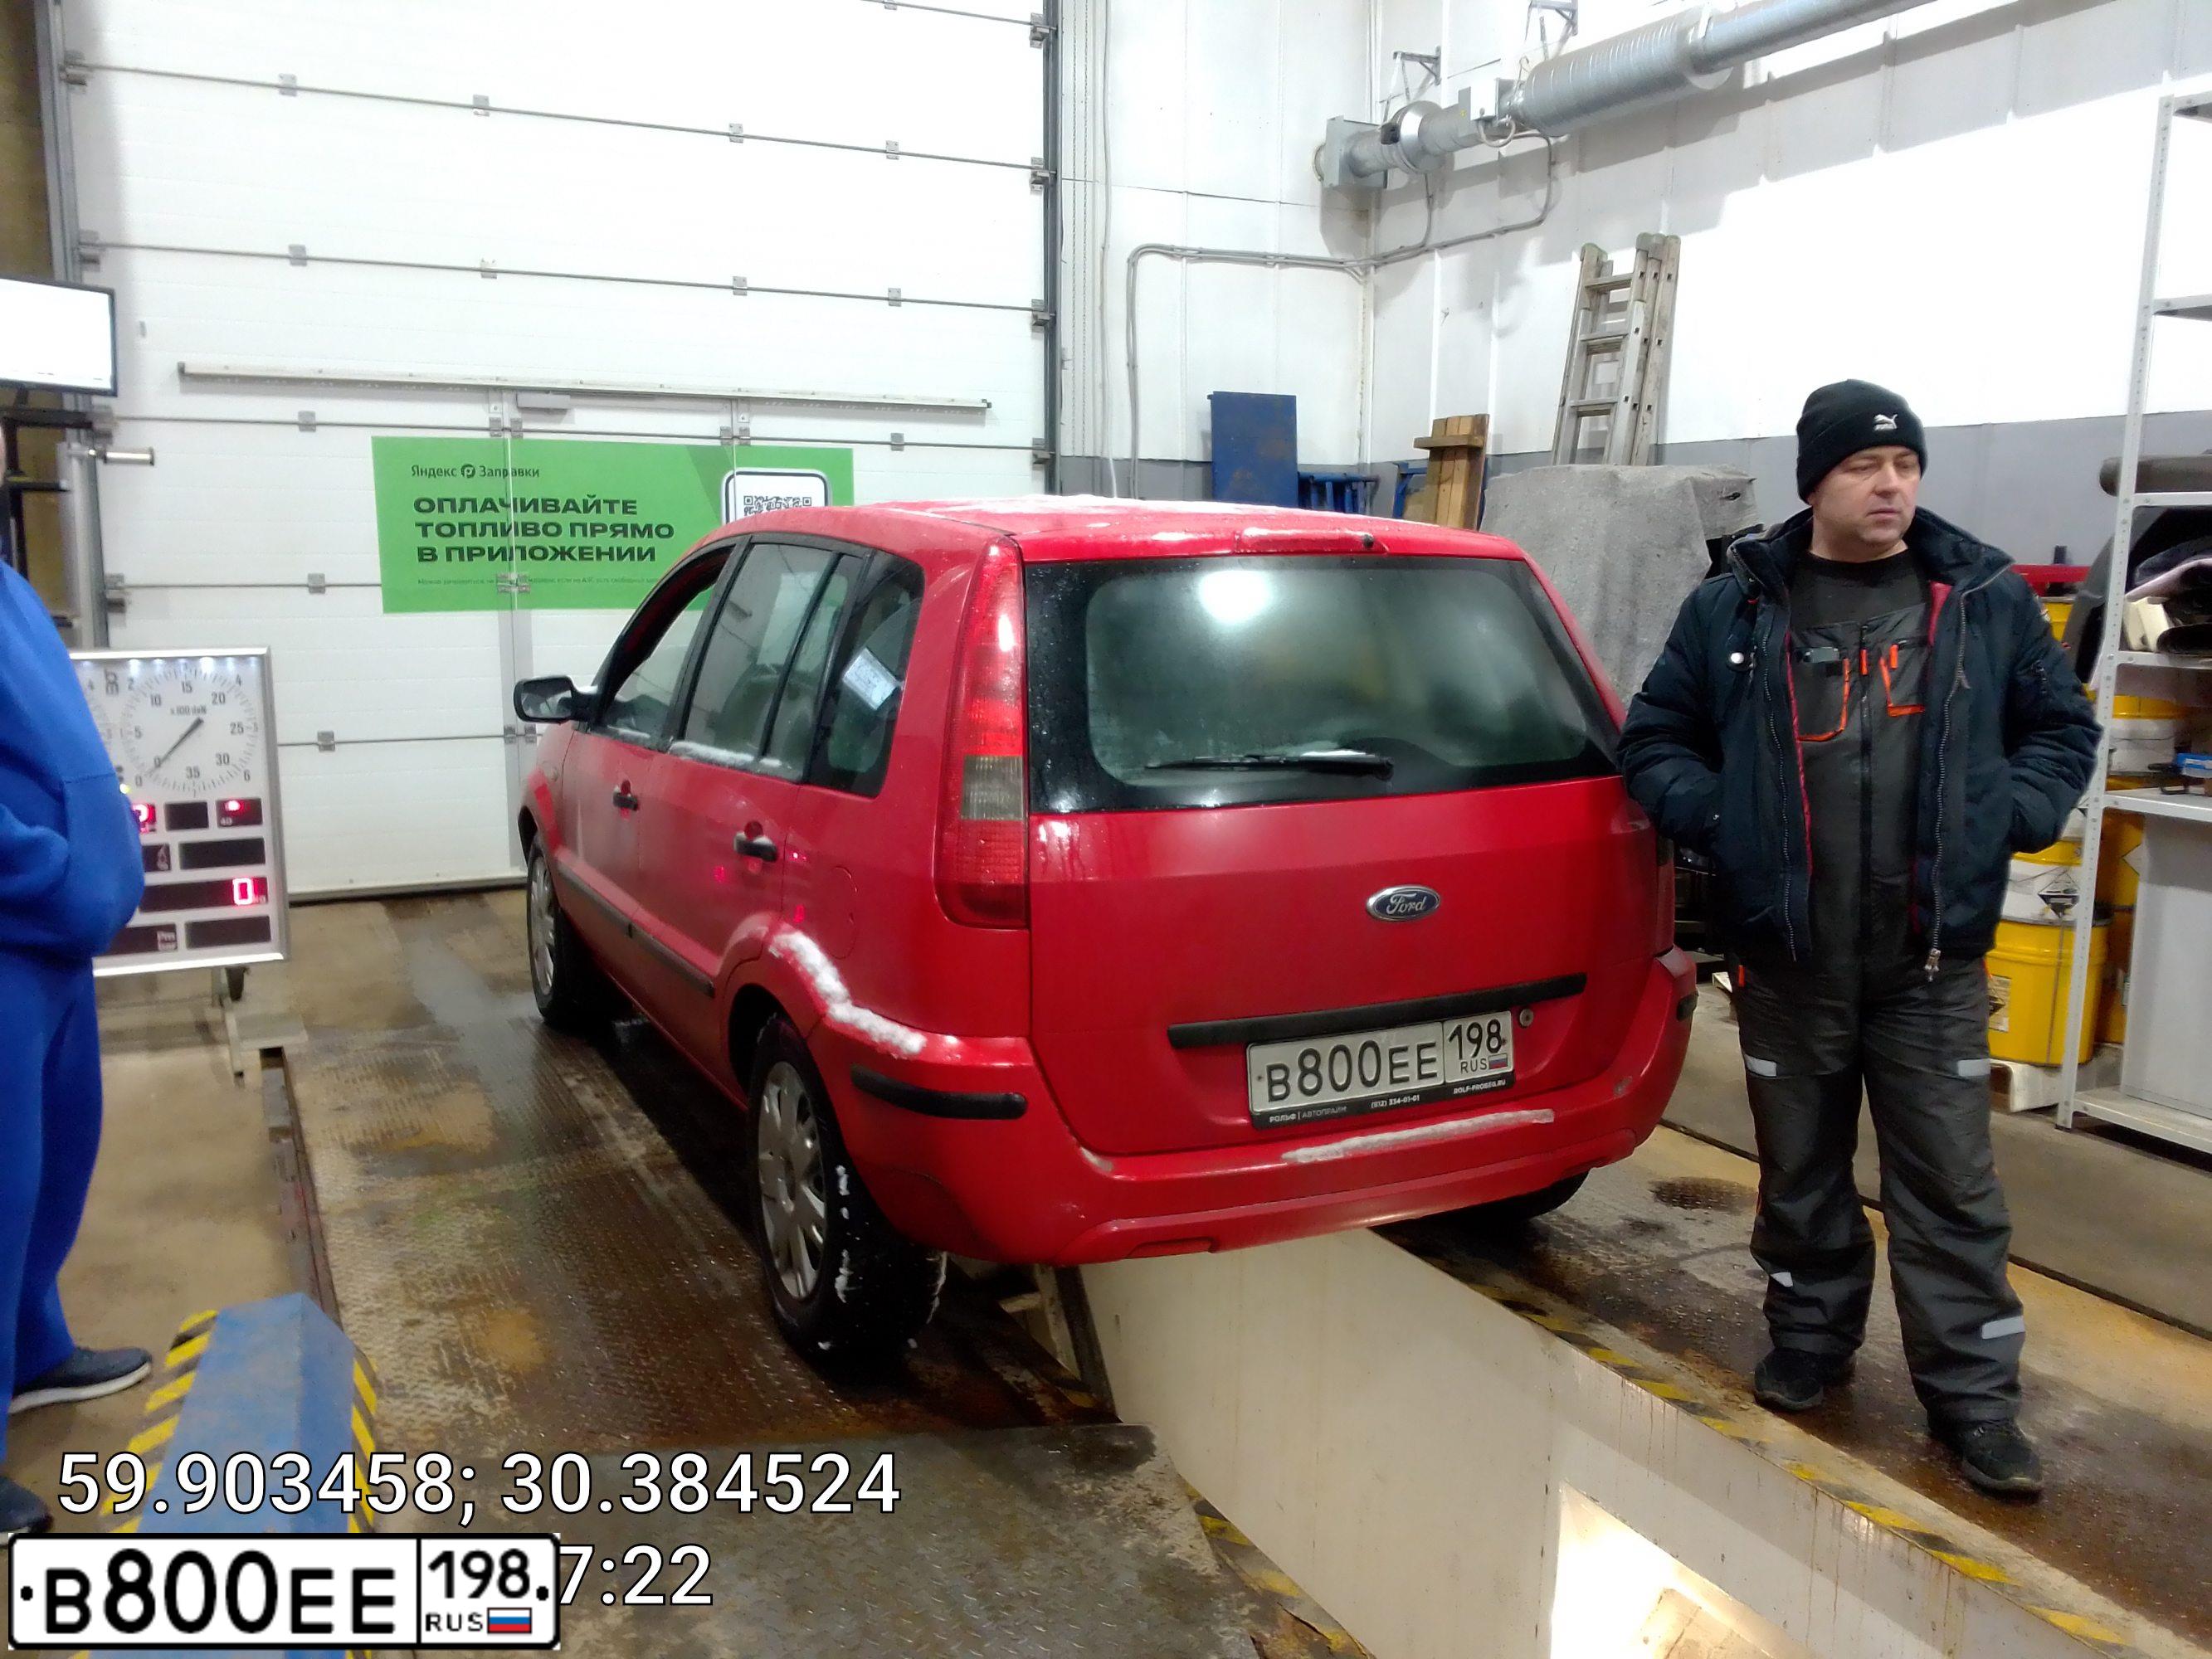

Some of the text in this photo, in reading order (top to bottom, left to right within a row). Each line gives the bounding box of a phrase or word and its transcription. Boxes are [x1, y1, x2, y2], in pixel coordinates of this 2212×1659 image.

[411, 464, 540, 479] Яндекс Заправки
[413, 494, 638, 515] ОПЛАЧИВАЙТЕ
[415, 521, 675, 540] ТОПЛИВО ПРЯМО
[417, 544, 656, 563] В ПРИЛОЖЕНИИ
[181, 680, 193, 694] 15
[149, 693, 162, 708] 10
[211, 691, 226, 705] 20
[134, 725, 143, 739] 5
[230, 721, 244, 735] 25
[215, 752, 230, 766] 30
[185, 765, 200, 779] 35
[232, 877, 256, 906] 0
[1386, 892, 1428, 916] Ford
[1448, 1018, 1503, 1061] 198
[1460, 1058, 1488, 1074] RUS
[1269, 1112, 1298, 1123] РОЛЬФ
